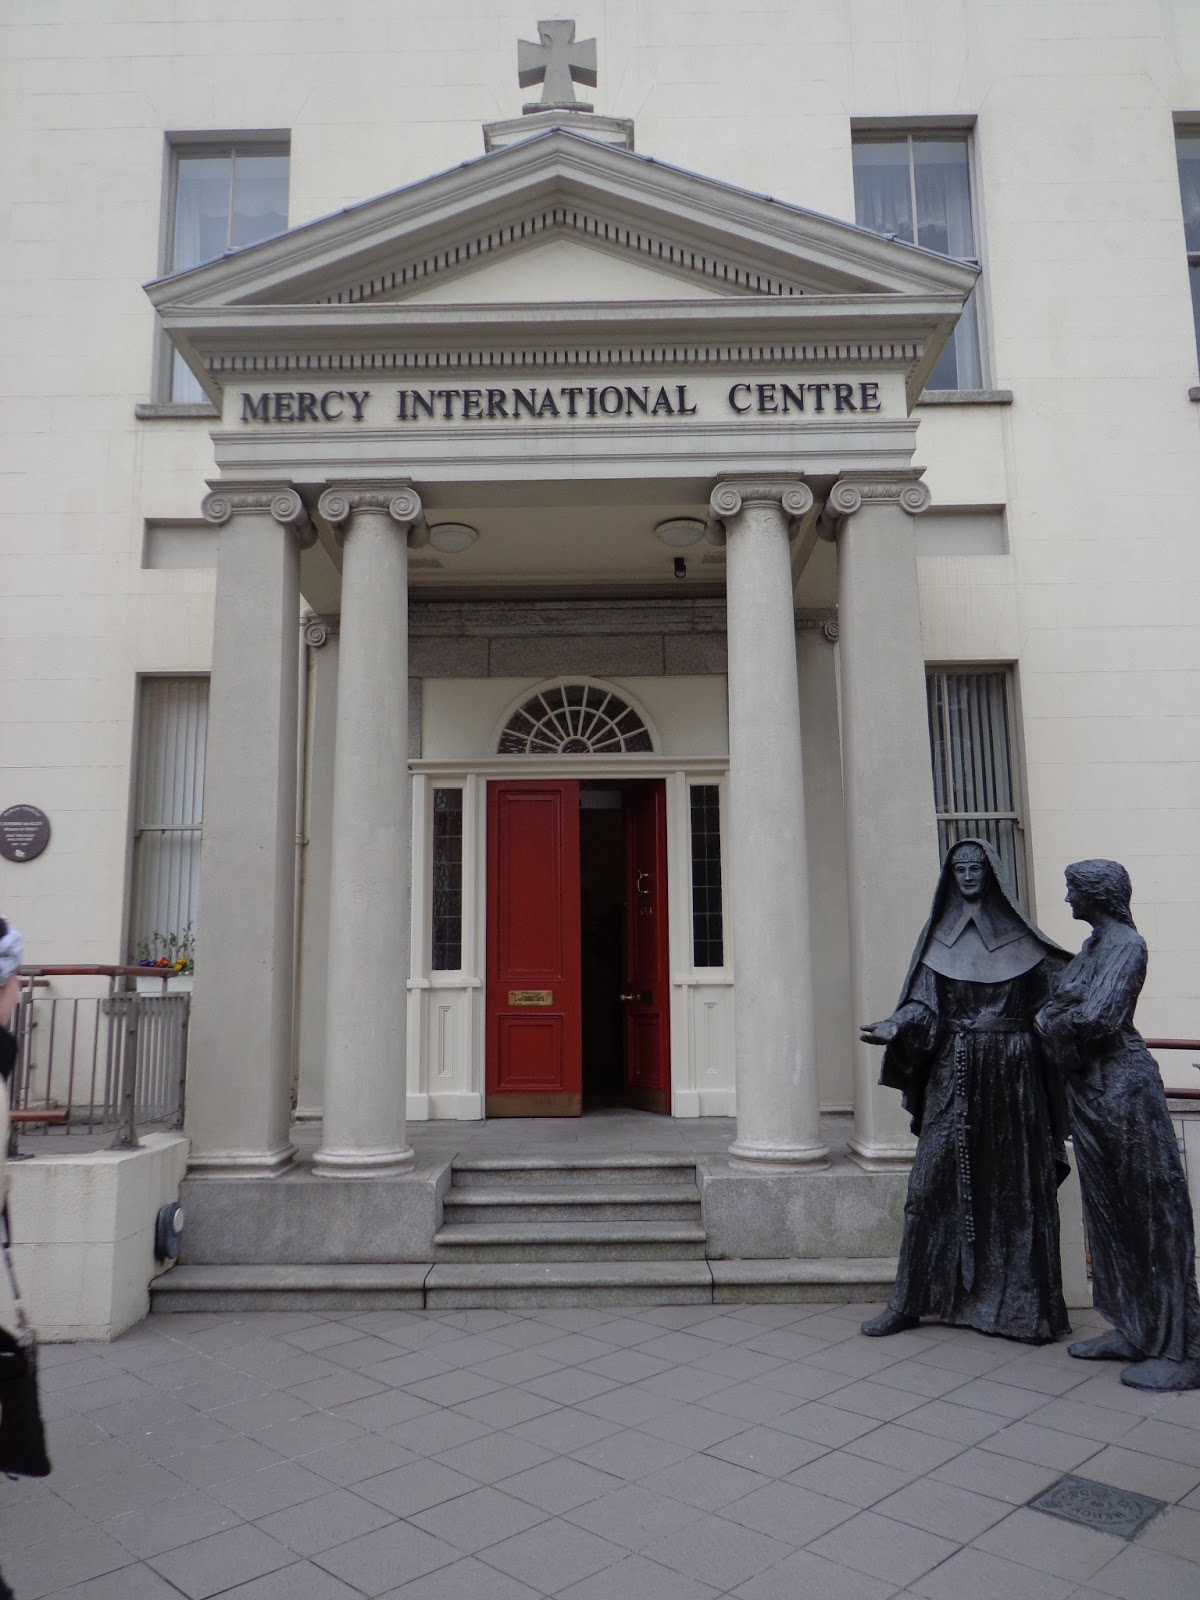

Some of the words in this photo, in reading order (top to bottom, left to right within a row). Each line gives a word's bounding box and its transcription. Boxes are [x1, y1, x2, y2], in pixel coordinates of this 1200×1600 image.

[240, 391, 370, 422] MERCY
[396, 385, 697, 419] INTERNATIONAL
[728, 382, 882, 413] CENTRE
